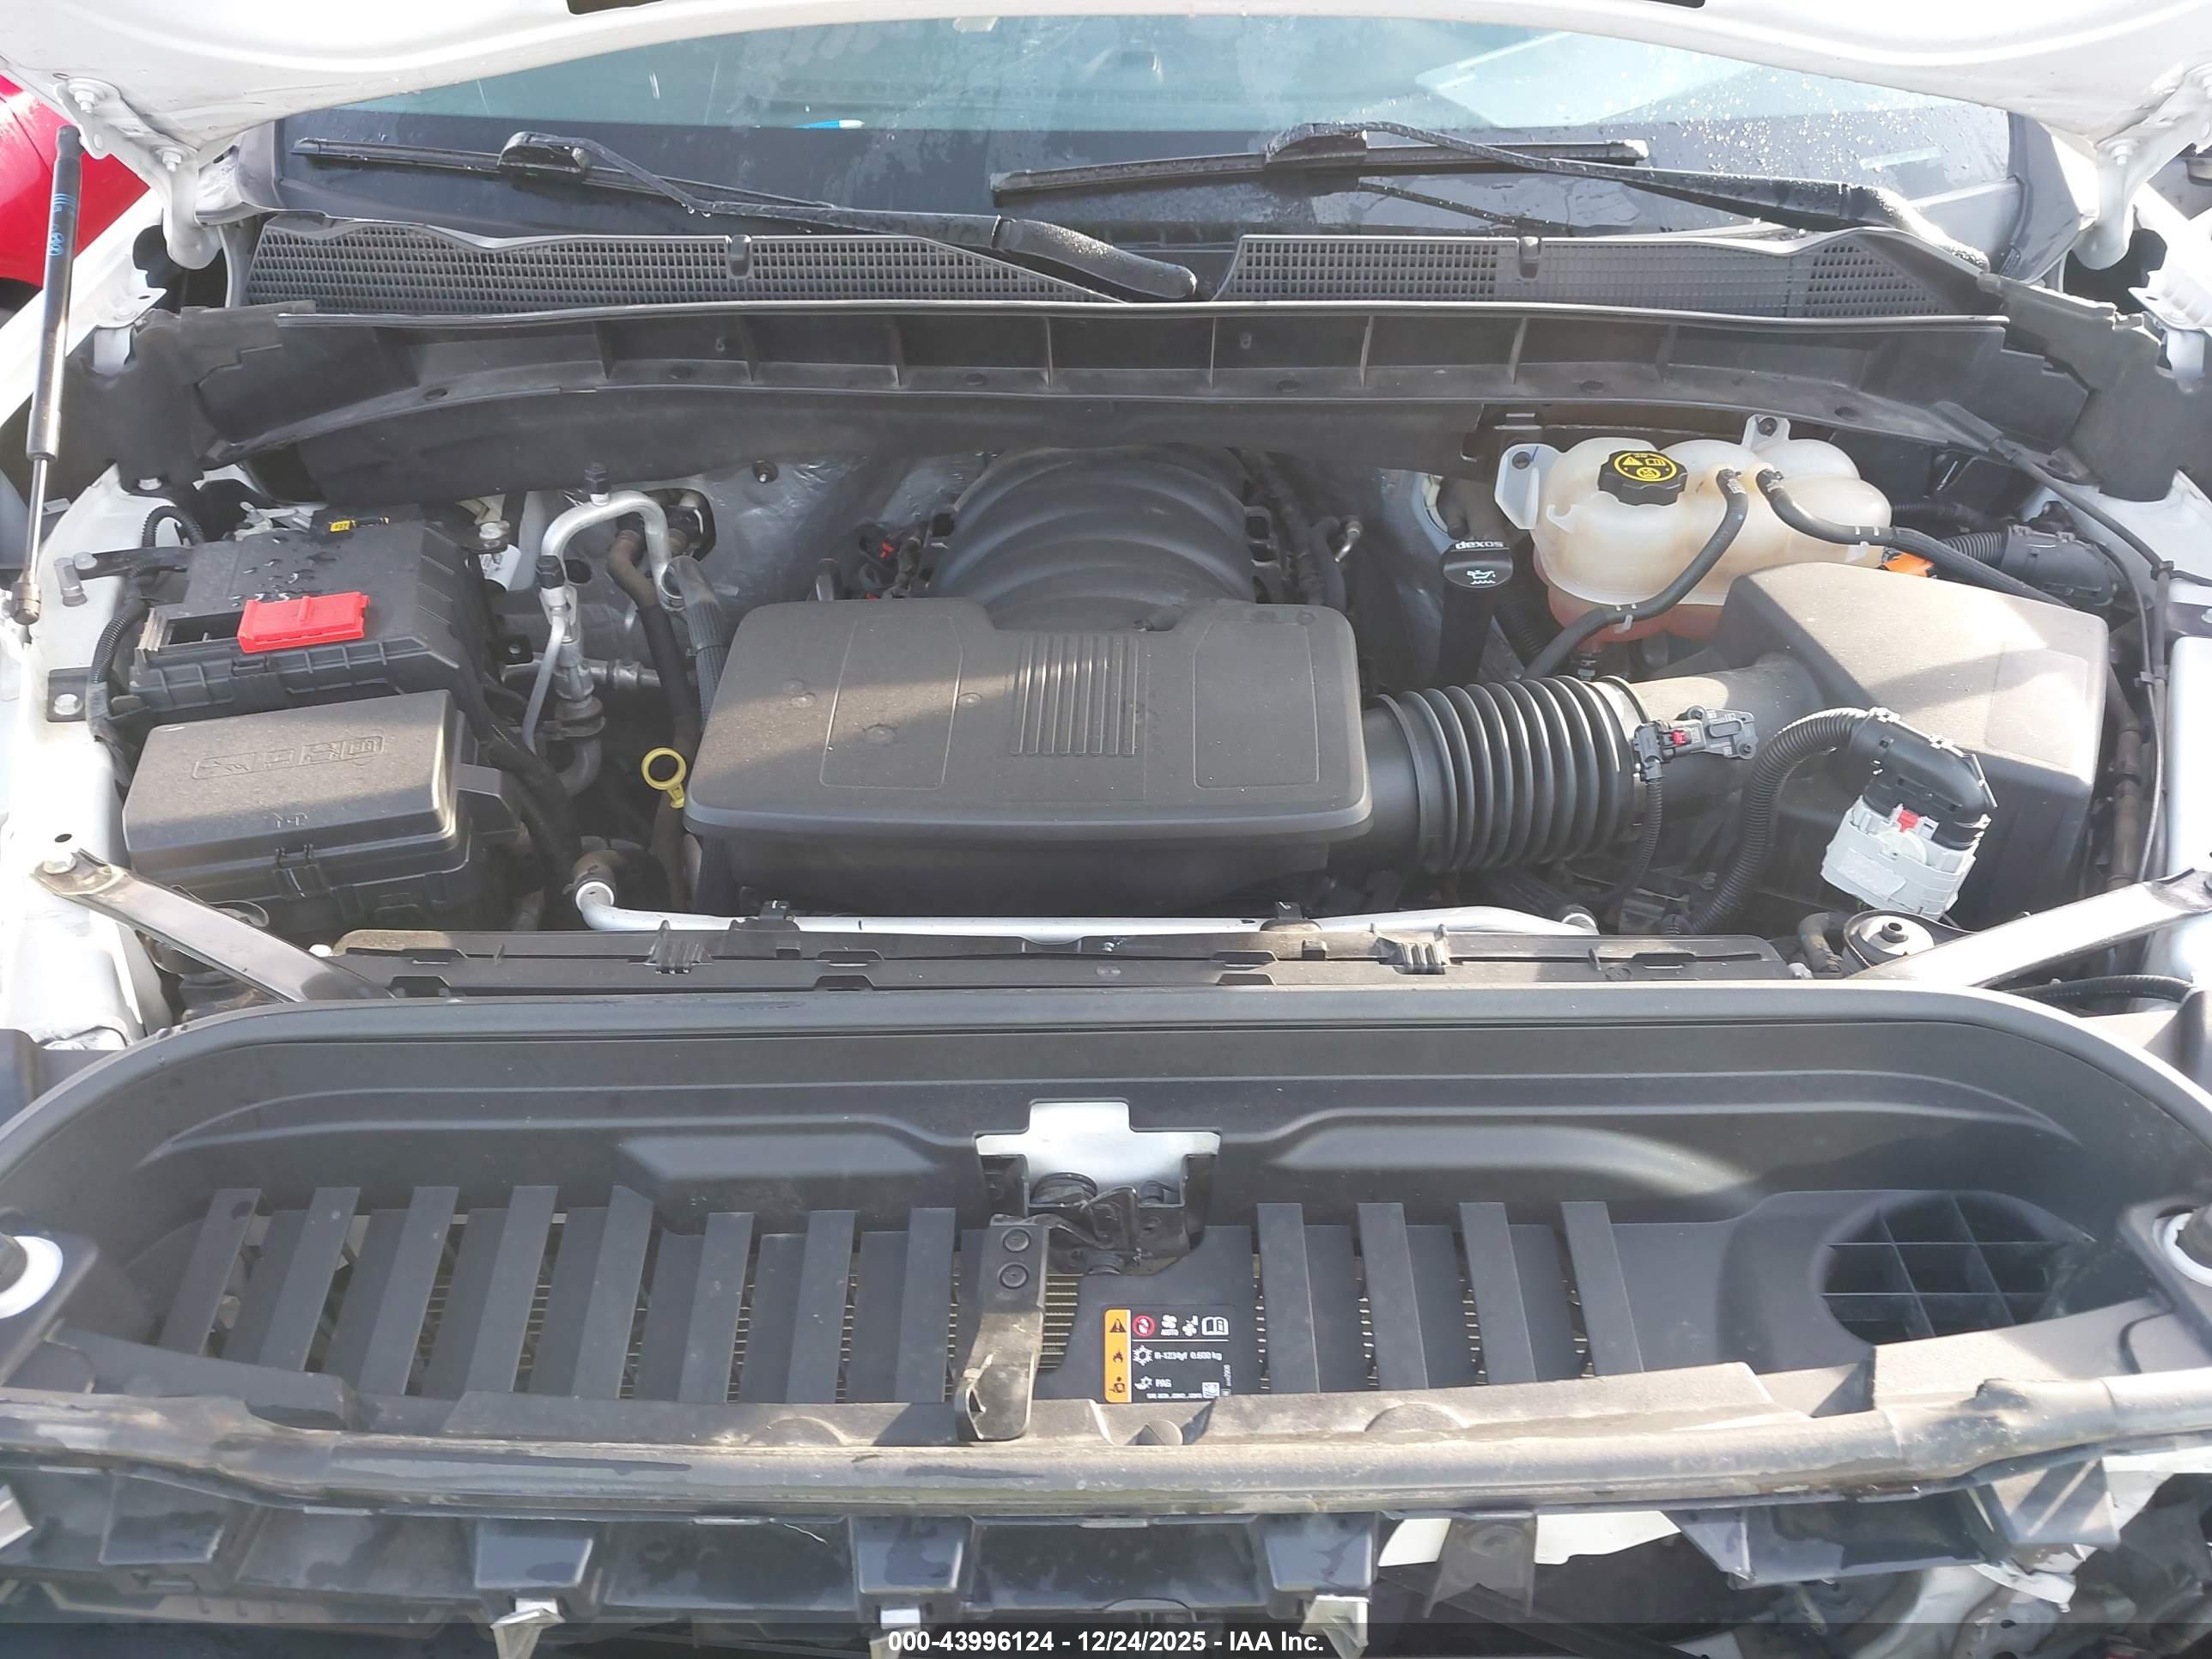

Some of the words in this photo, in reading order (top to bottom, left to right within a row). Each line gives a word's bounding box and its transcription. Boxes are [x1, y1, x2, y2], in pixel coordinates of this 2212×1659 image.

[1455, 540, 1504, 550] dexos
[1212, 1352, 1222, 1361] kg
[1155, 1378, 1172, 1389] PAG
